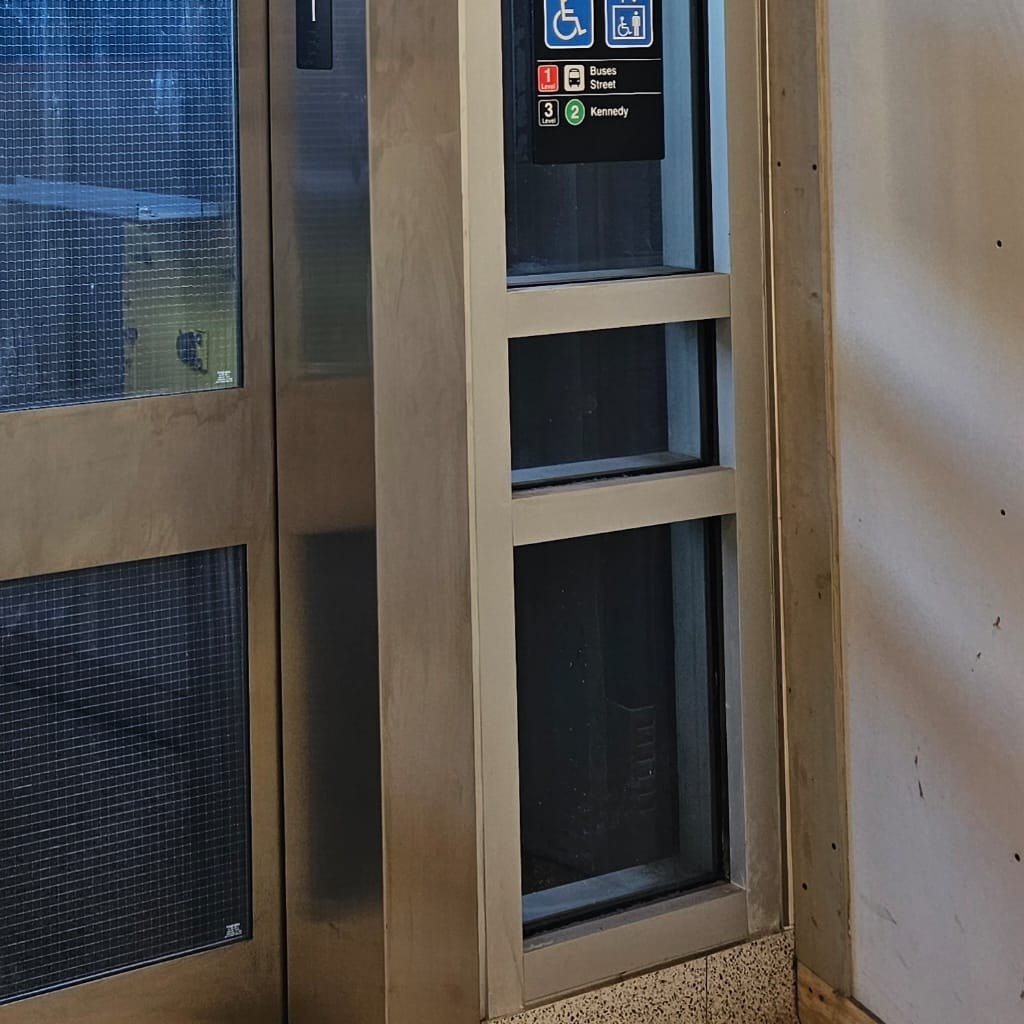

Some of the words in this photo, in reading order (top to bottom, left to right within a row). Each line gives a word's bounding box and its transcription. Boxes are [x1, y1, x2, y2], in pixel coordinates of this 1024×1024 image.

[544, 68, 551, 83] 1
[590, 66, 617, 76] Buses
[590, 79, 616, 90] Street
[544, 102, 554, 118] 3
[570, 105, 580, 120] 2
[590, 106, 629, 119] Kennedy
